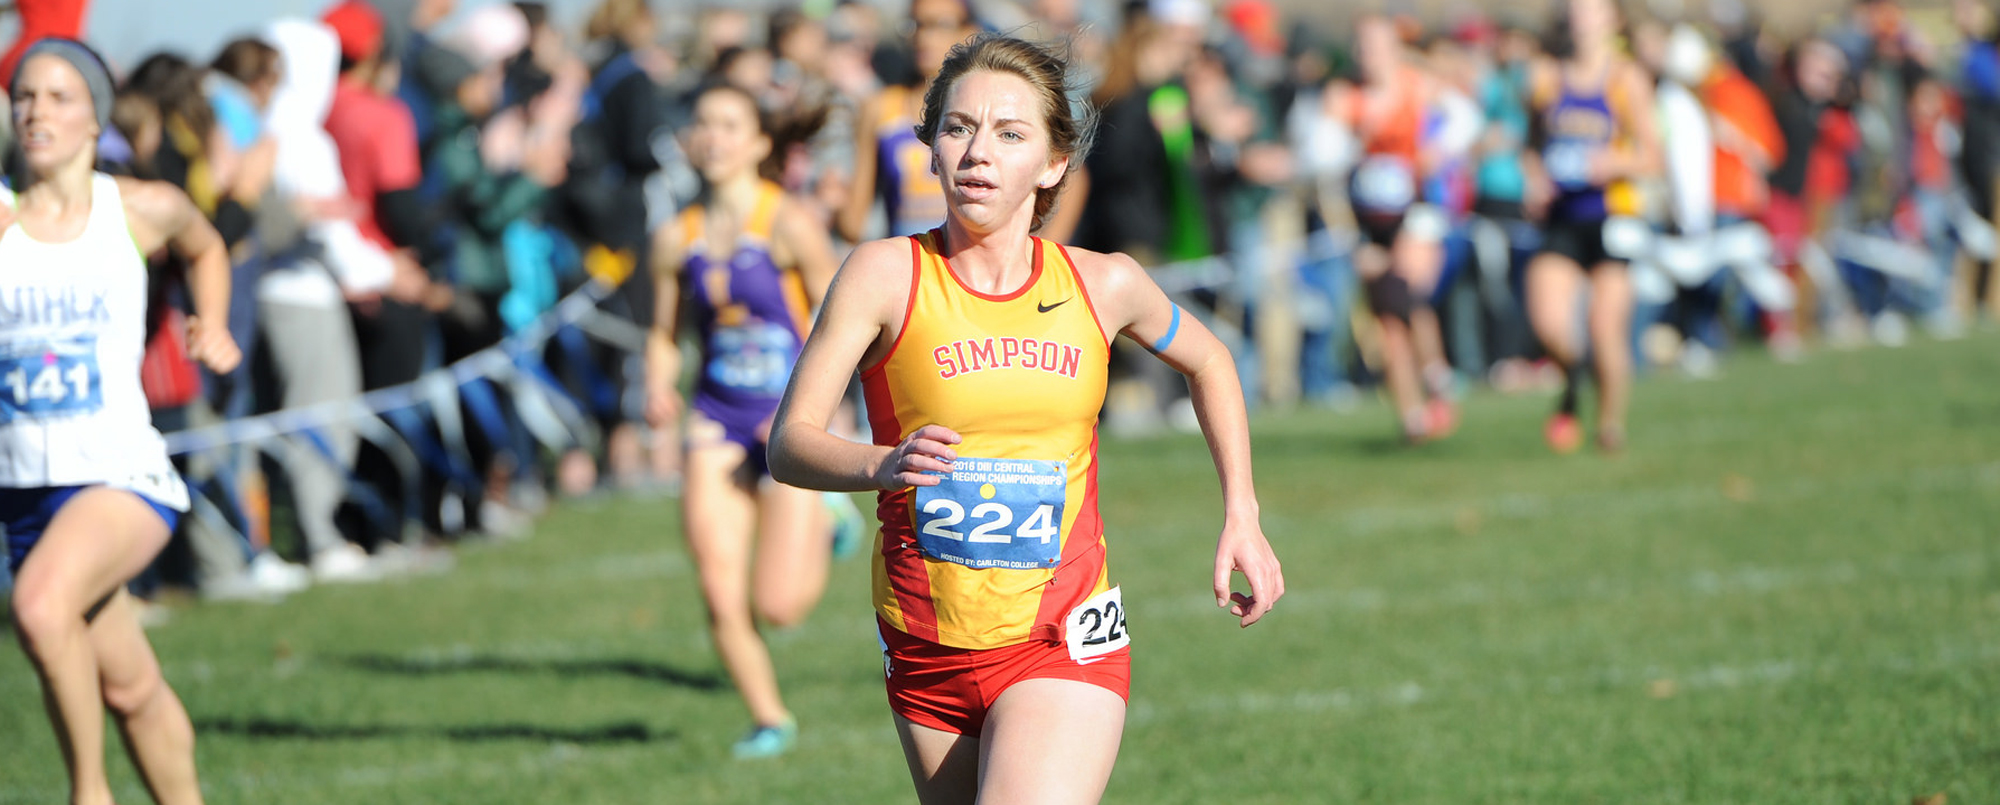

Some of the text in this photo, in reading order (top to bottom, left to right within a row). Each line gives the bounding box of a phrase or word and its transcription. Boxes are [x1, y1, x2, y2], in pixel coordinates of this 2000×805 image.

[933, 337, 1082, 379] SIMPSON
[5, 362, 90, 405] 141
[952, 472, 987, 483] REGION
[987, 473, 1063, 486] CHAMPIONSHIPS
[953, 461, 975, 471] 2016
[994, 463, 1035, 473] CENTRAL
[922, 499, 1058, 544] 224
[940, 553, 1039, 569] HOSTED BY: CARLETON COLLEGE
